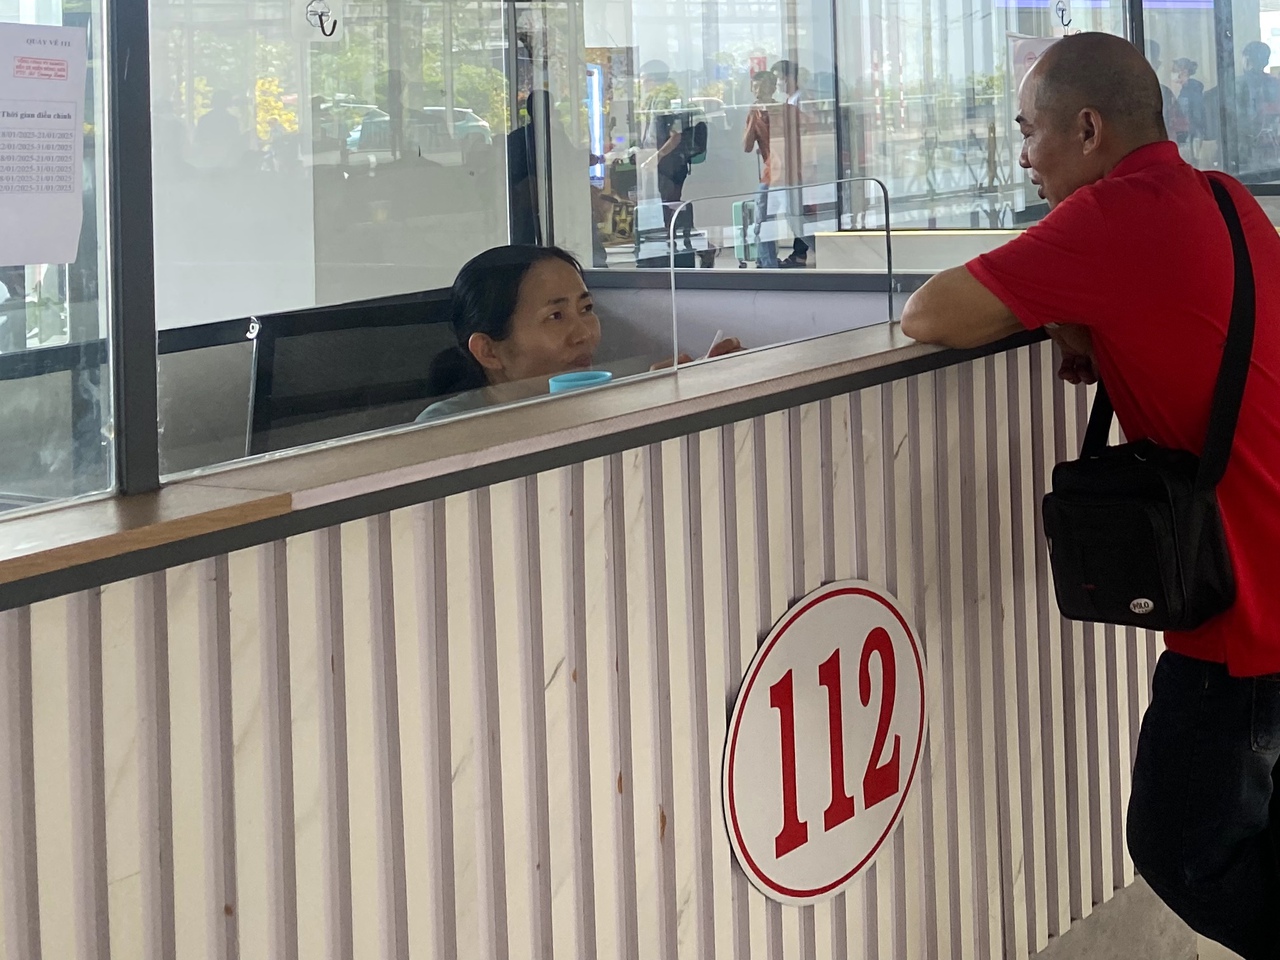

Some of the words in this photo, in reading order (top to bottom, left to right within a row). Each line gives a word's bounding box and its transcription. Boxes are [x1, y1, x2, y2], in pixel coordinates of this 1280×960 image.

[20, 112, 35, 120] gian
[1132, 601, 1150, 610] POLO
[769, 626, 900, 859] 112
